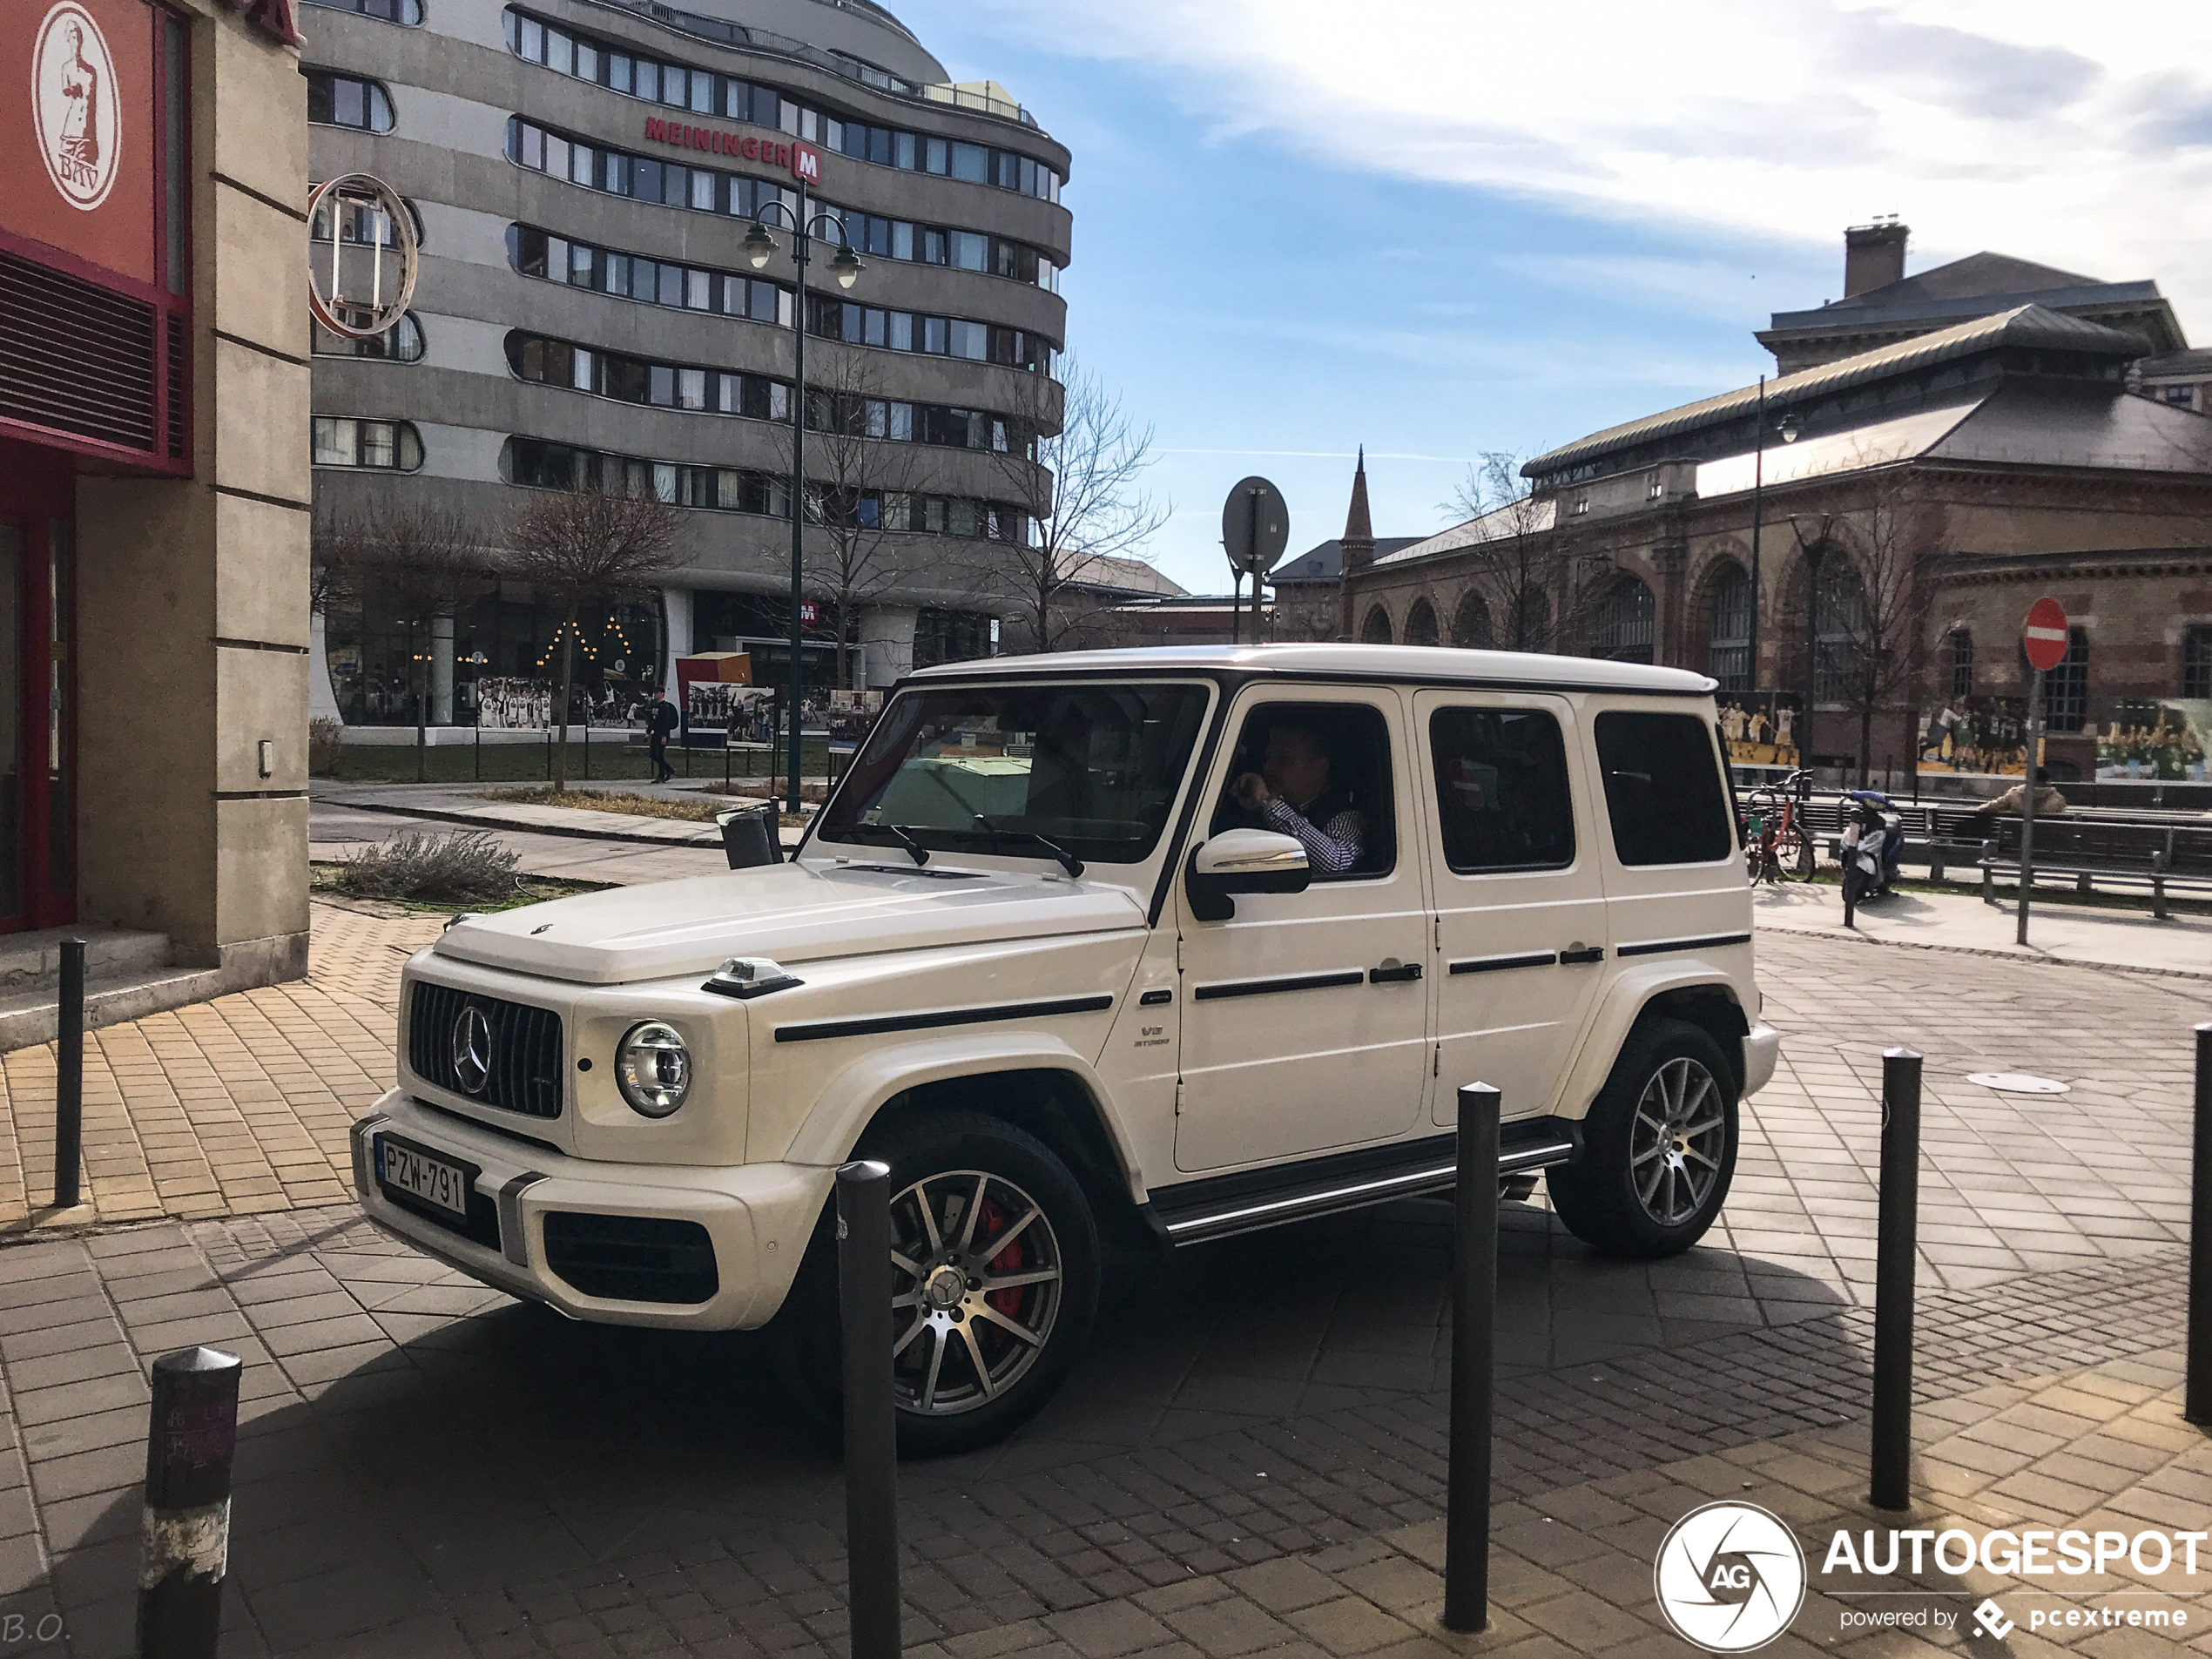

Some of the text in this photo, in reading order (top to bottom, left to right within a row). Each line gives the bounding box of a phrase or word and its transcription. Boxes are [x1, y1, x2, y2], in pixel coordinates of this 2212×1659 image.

[645, 116, 817, 178] MEININGER M
[387, 1146, 460, 1208] PZW-791
